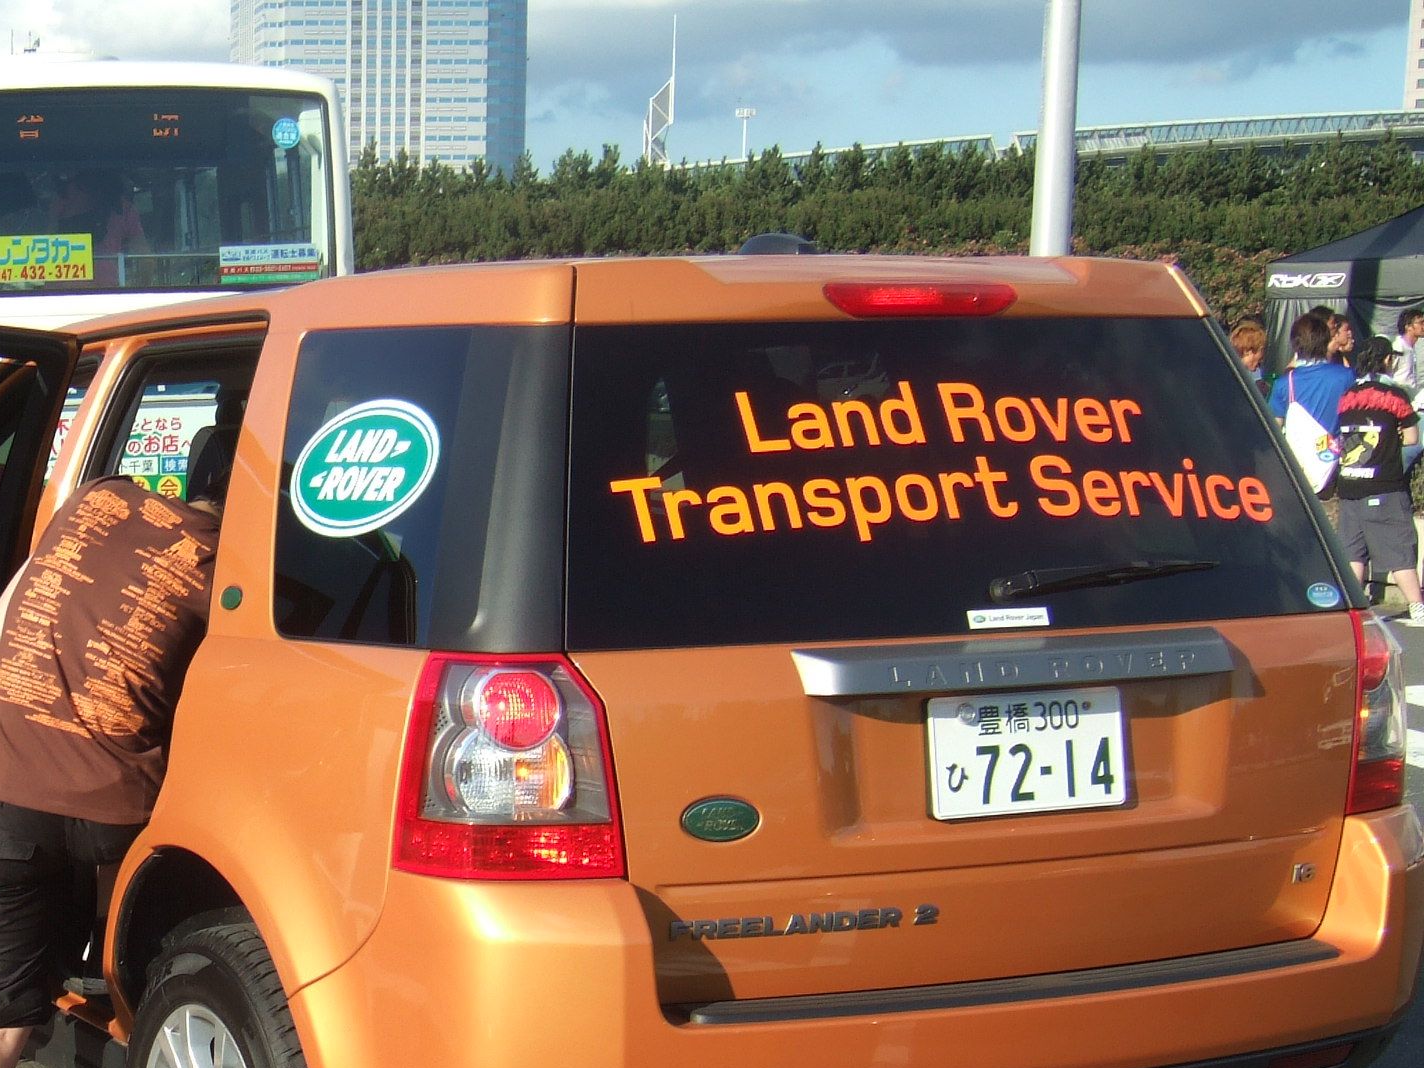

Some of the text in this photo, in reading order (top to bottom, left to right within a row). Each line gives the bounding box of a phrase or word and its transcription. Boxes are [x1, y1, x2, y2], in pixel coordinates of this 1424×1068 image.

[736, 381, 1142, 454] Land Rover
[324, 428, 398, 463] LAND
[317, 466, 406, 502] ROVER
[610, 454, 1274, 544] Transport Service
[888, 651, 1196, 688] LAND ROVER
[976, 737, 1115, 806] 72-14
[670, 903, 940, 941] FREELANDER 2
